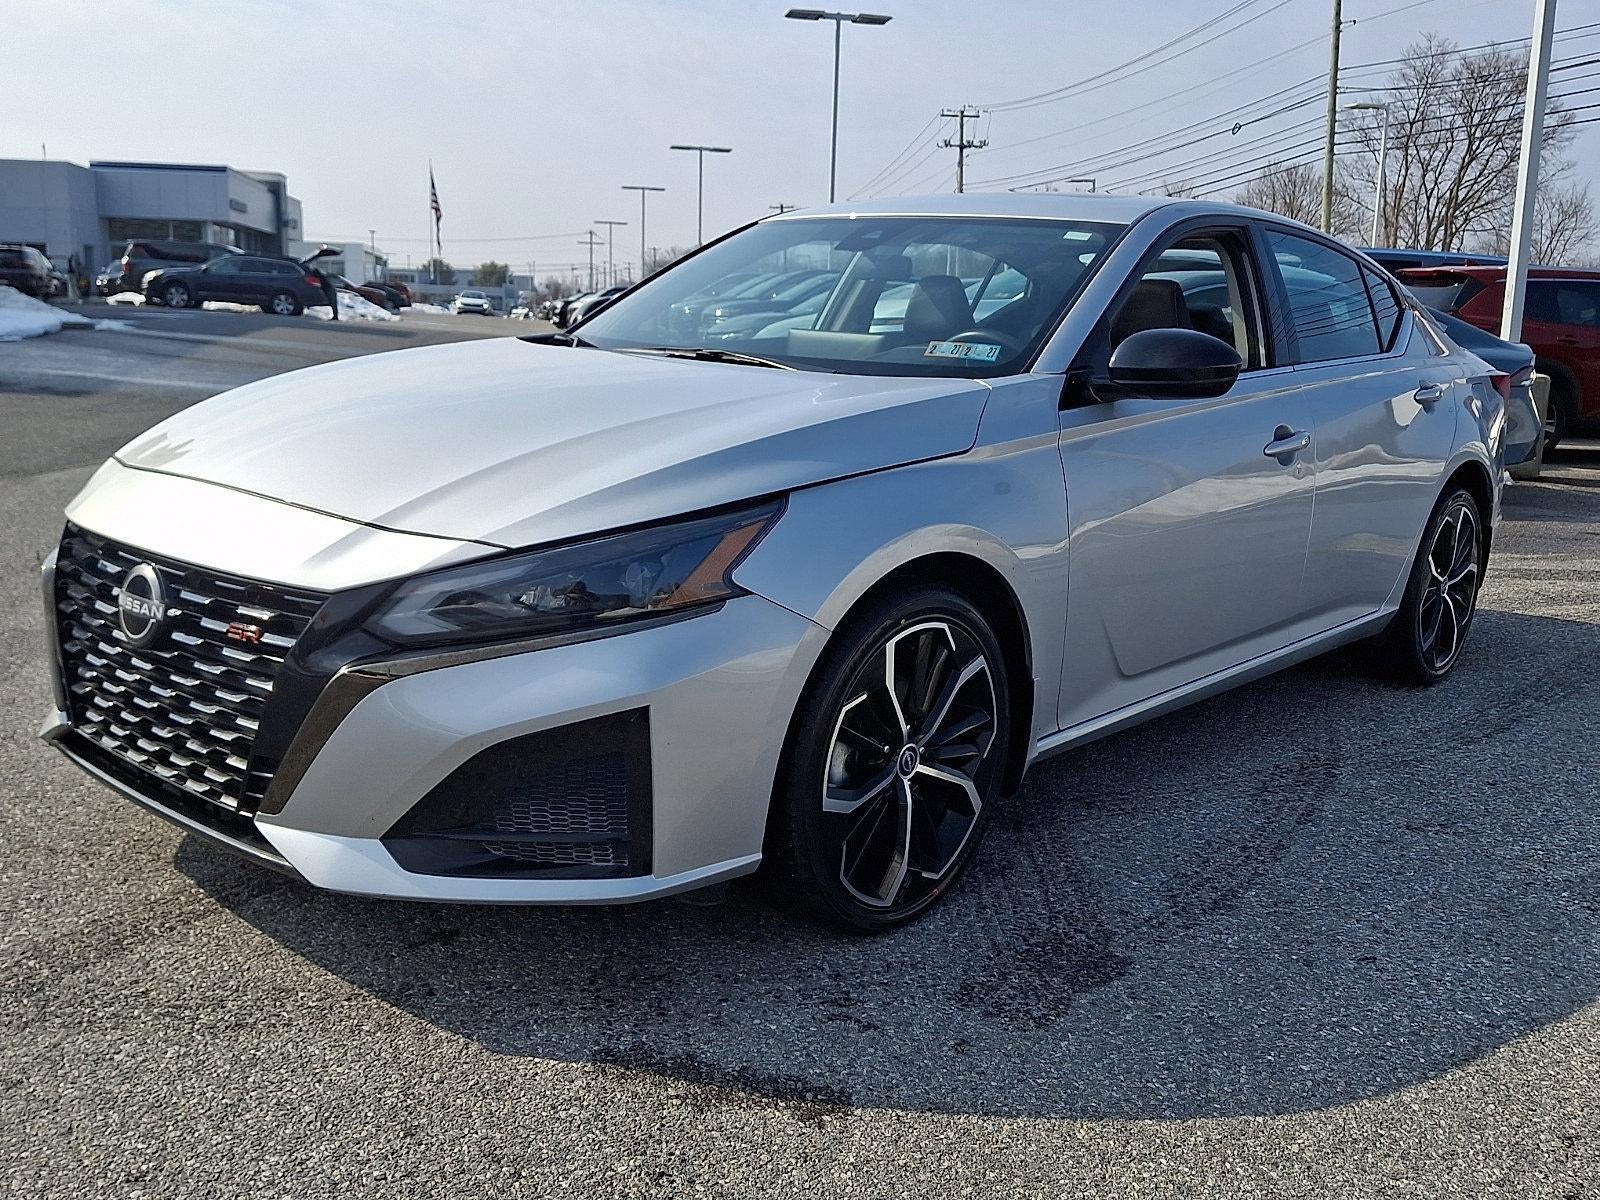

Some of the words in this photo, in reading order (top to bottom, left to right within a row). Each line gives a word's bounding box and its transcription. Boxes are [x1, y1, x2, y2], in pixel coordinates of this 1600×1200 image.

[929, 345, 938, 354] 2
[950, 344, 962, 355] 27
[963, 347, 972, 357] 2
[986, 347, 998, 359] 27
[119, 594, 163, 619] SSAN
[227, 622, 262, 644] SR
